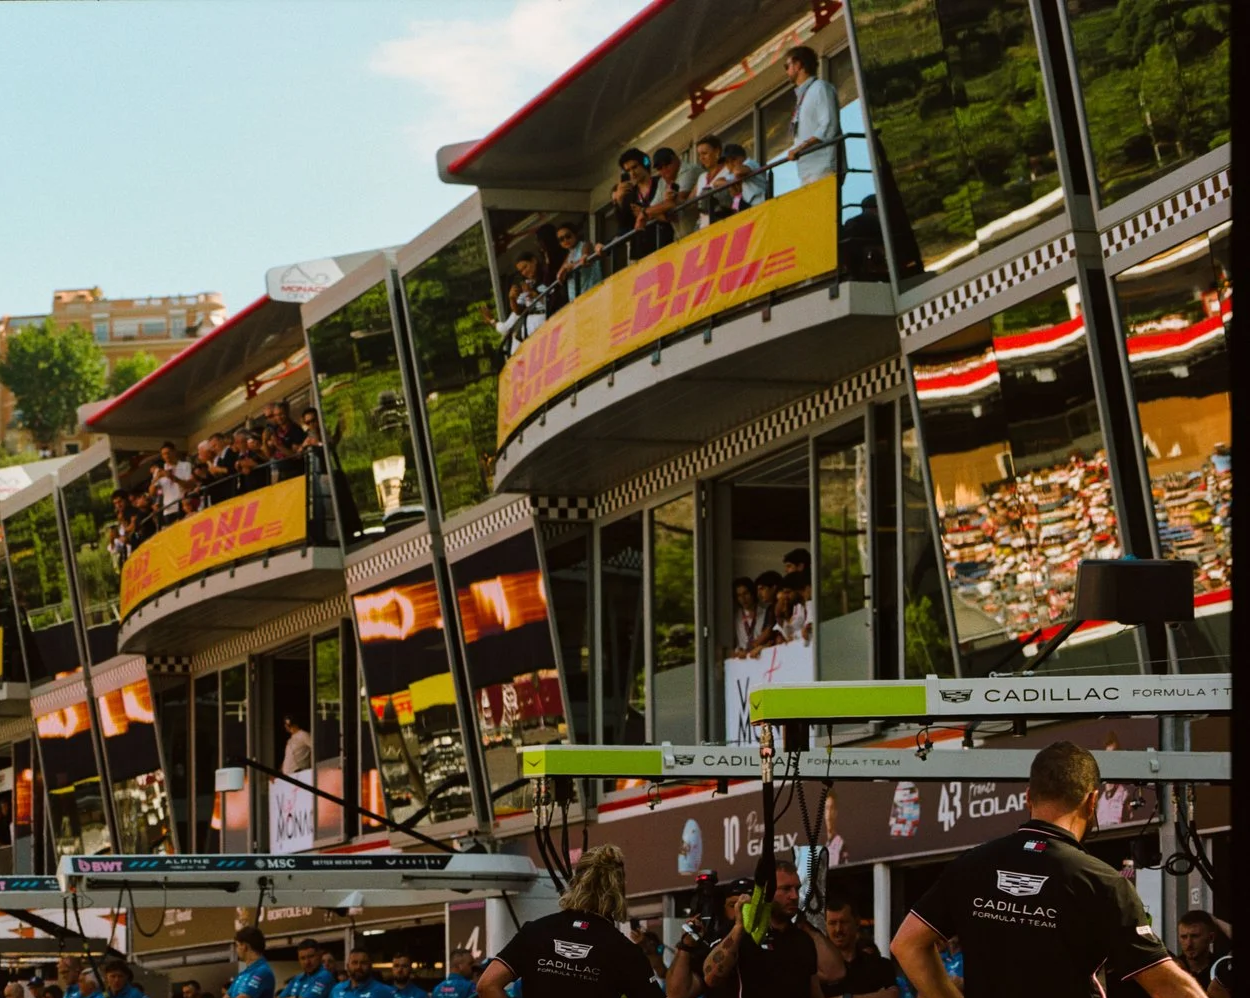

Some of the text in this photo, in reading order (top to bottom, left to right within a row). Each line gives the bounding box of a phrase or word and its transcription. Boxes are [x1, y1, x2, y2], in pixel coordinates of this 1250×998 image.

[630, 221, 764, 337] DHL
[190, 500, 264, 566] DHL
[984, 687, 1120, 702] CADILLAC
[1132, 688, 1205, 698] FORMULA
[703, 755, 797, 767] CADILA
[807, 758, 859, 766] FORMULA
[91, 861, 123, 872] BWT
[267, 859, 296, 869] MSC
[973, 897, 1058, 919] CADILLAC
[972, 911, 1016, 923] FORMULA
[1028, 919, 1057, 929] TEAM
[537, 959, 601, 975] CADILLAC
[537, 967, 570, 977] FORMULA
